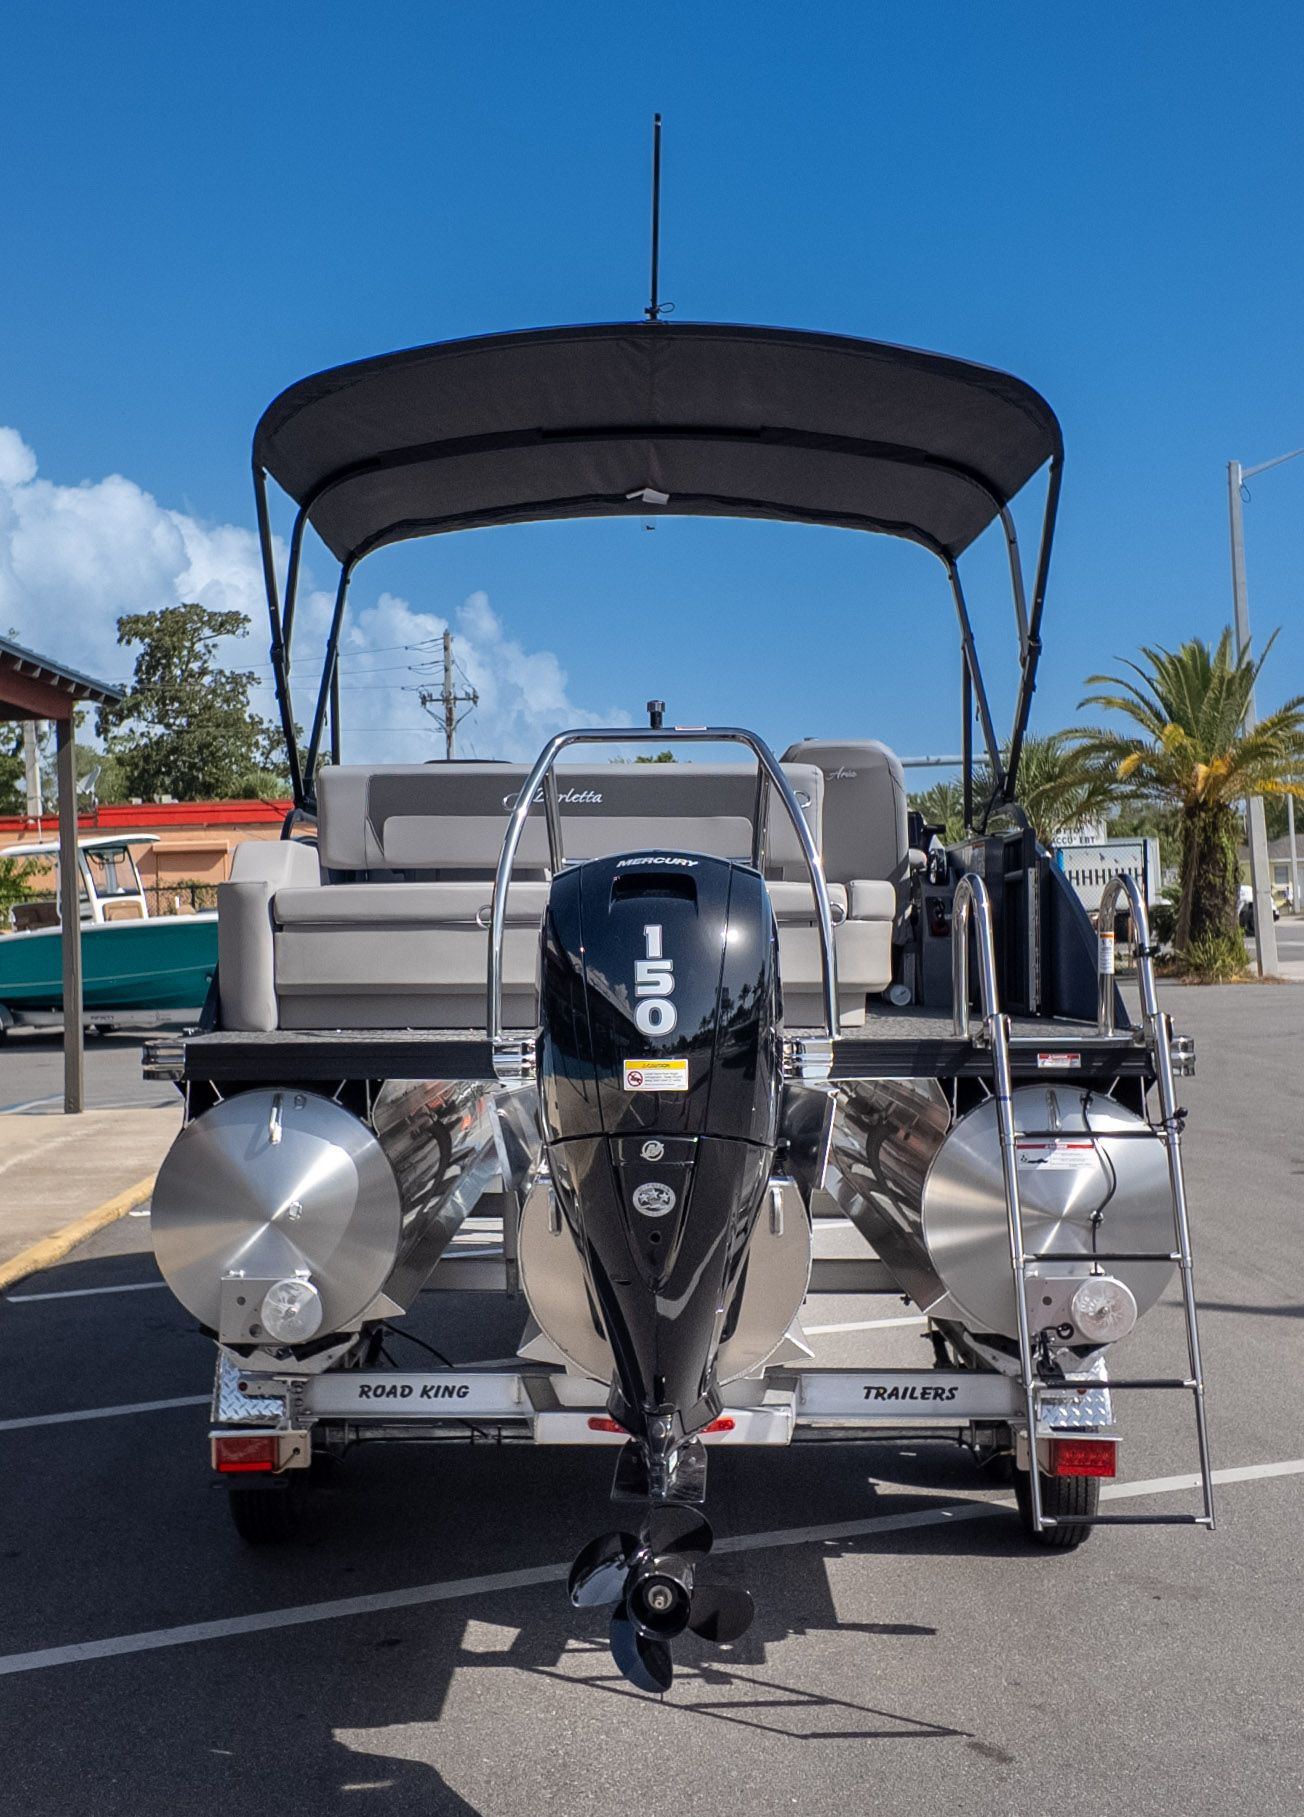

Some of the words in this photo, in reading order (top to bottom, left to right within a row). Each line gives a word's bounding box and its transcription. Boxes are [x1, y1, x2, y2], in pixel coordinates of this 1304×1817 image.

[616, 857, 699, 868] MERCURY
[634, 924, 678, 1037] 150
[359, 1384, 414, 1399] ROAD
[419, 1384, 470, 1399] KING
[863, 1386, 959, 1401] TRAILERS
